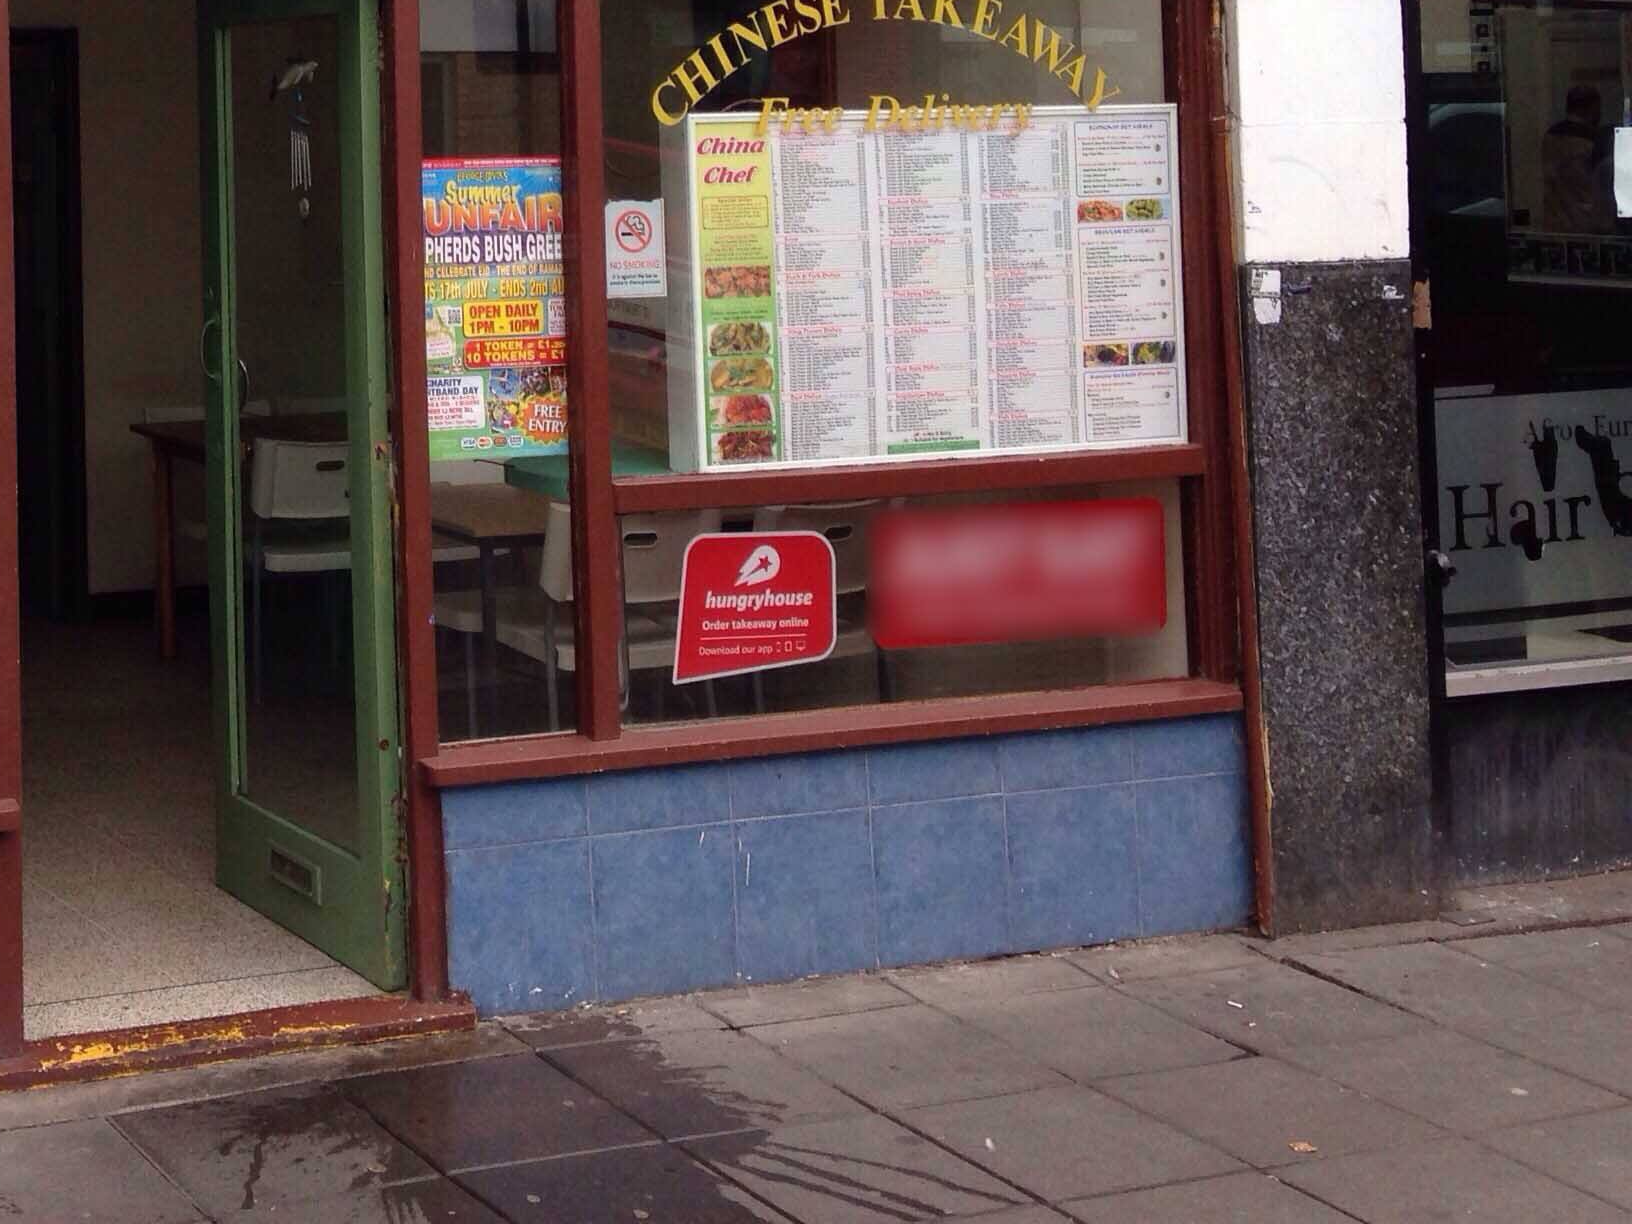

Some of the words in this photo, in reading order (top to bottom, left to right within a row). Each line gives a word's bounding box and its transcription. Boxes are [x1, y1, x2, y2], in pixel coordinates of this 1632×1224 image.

[754, 96, 843, 136] Free
[867, 93, 1032, 139] Delivery
[697, 136, 765, 156] China
[703, 165, 758, 184] Chef
[446, 181, 522, 206] Summer
[484, 234, 523, 263] BUSH
[464, 278, 488, 298] JULY
[500, 278, 526, 298] ENDS
[469, 306, 501, 318] OPEN
[505, 303, 538, 317] DAILY
[469, 320, 494, 334] 1PM
[509, 319, 540, 333] 10PM
[485, 340, 524, 351] TOKEN
[484, 350, 535, 363] TOKENS
[463, 386, 479, 395] DAY
[534, 404, 562, 418] FREE
[529, 419, 567, 433] ENTRY
[1446, 482, 1591, 553] Hair
[705, 588, 814, 612] hungryhouse
[702, 619, 730, 631] Order
[732, 618, 777, 631] takeaway
[779, 617, 809, 628] online
[699, 644, 740, 656] Download
[741, 646, 756, 655] our
[757, 645, 773, 656] app
